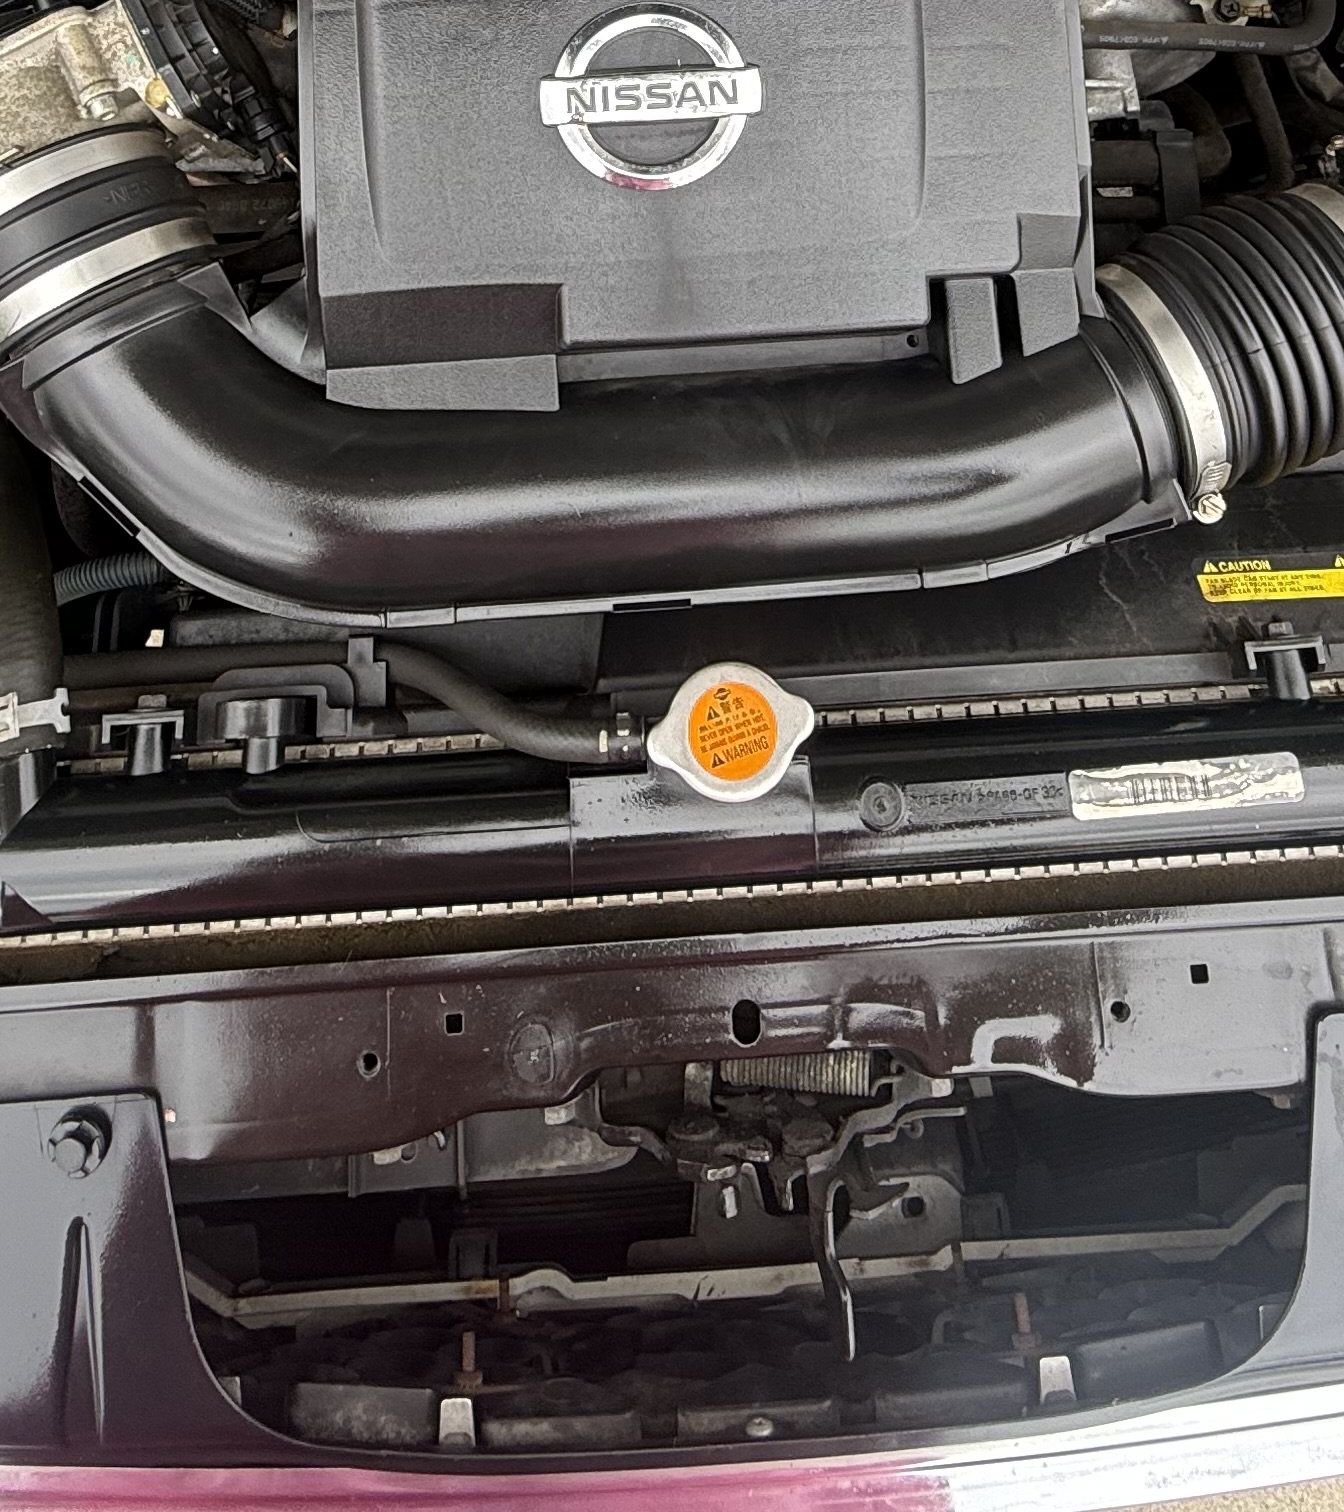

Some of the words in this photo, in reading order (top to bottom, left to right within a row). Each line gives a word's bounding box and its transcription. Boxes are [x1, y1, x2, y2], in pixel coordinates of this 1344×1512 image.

[566, 78, 739, 114] NISSAN
[1218, 559, 1272, 573] CAUTION
[723, 736, 770, 762] WARNING
